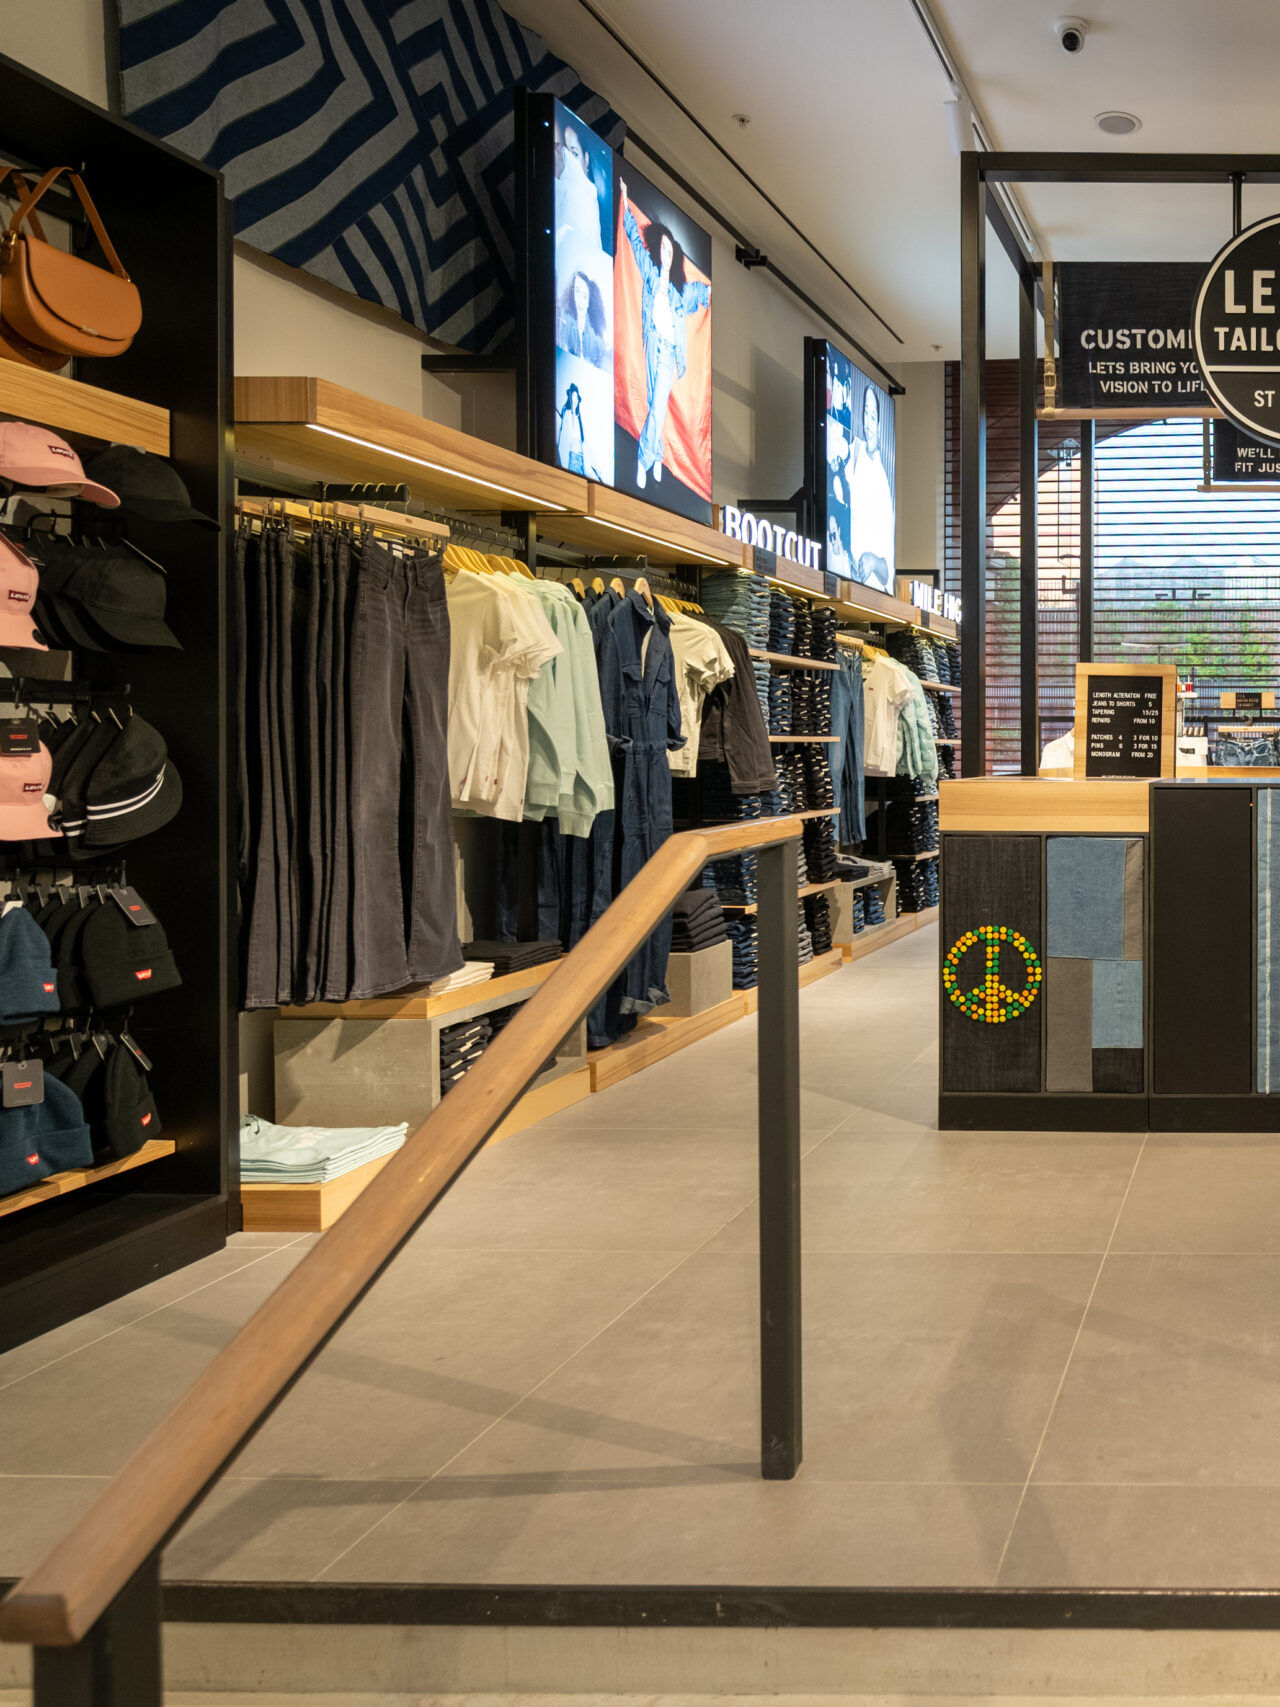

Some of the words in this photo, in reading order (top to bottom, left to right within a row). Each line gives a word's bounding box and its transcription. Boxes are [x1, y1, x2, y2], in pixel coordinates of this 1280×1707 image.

[1088, 361, 1125, 374] LETS
[1129, 362, 1177, 374] BRING
[1100, 380, 1149, 394] VISION
[1152, 380, 1172, 393] TO
[1254, 390, 1276, 408] ST
[1237, 447, 1275, 459] WE'LL
[1234, 462, 1254, 473] FIT
[724, 504, 822, 571] BOOTCUT
[913, 579, 942, 616] MILE
